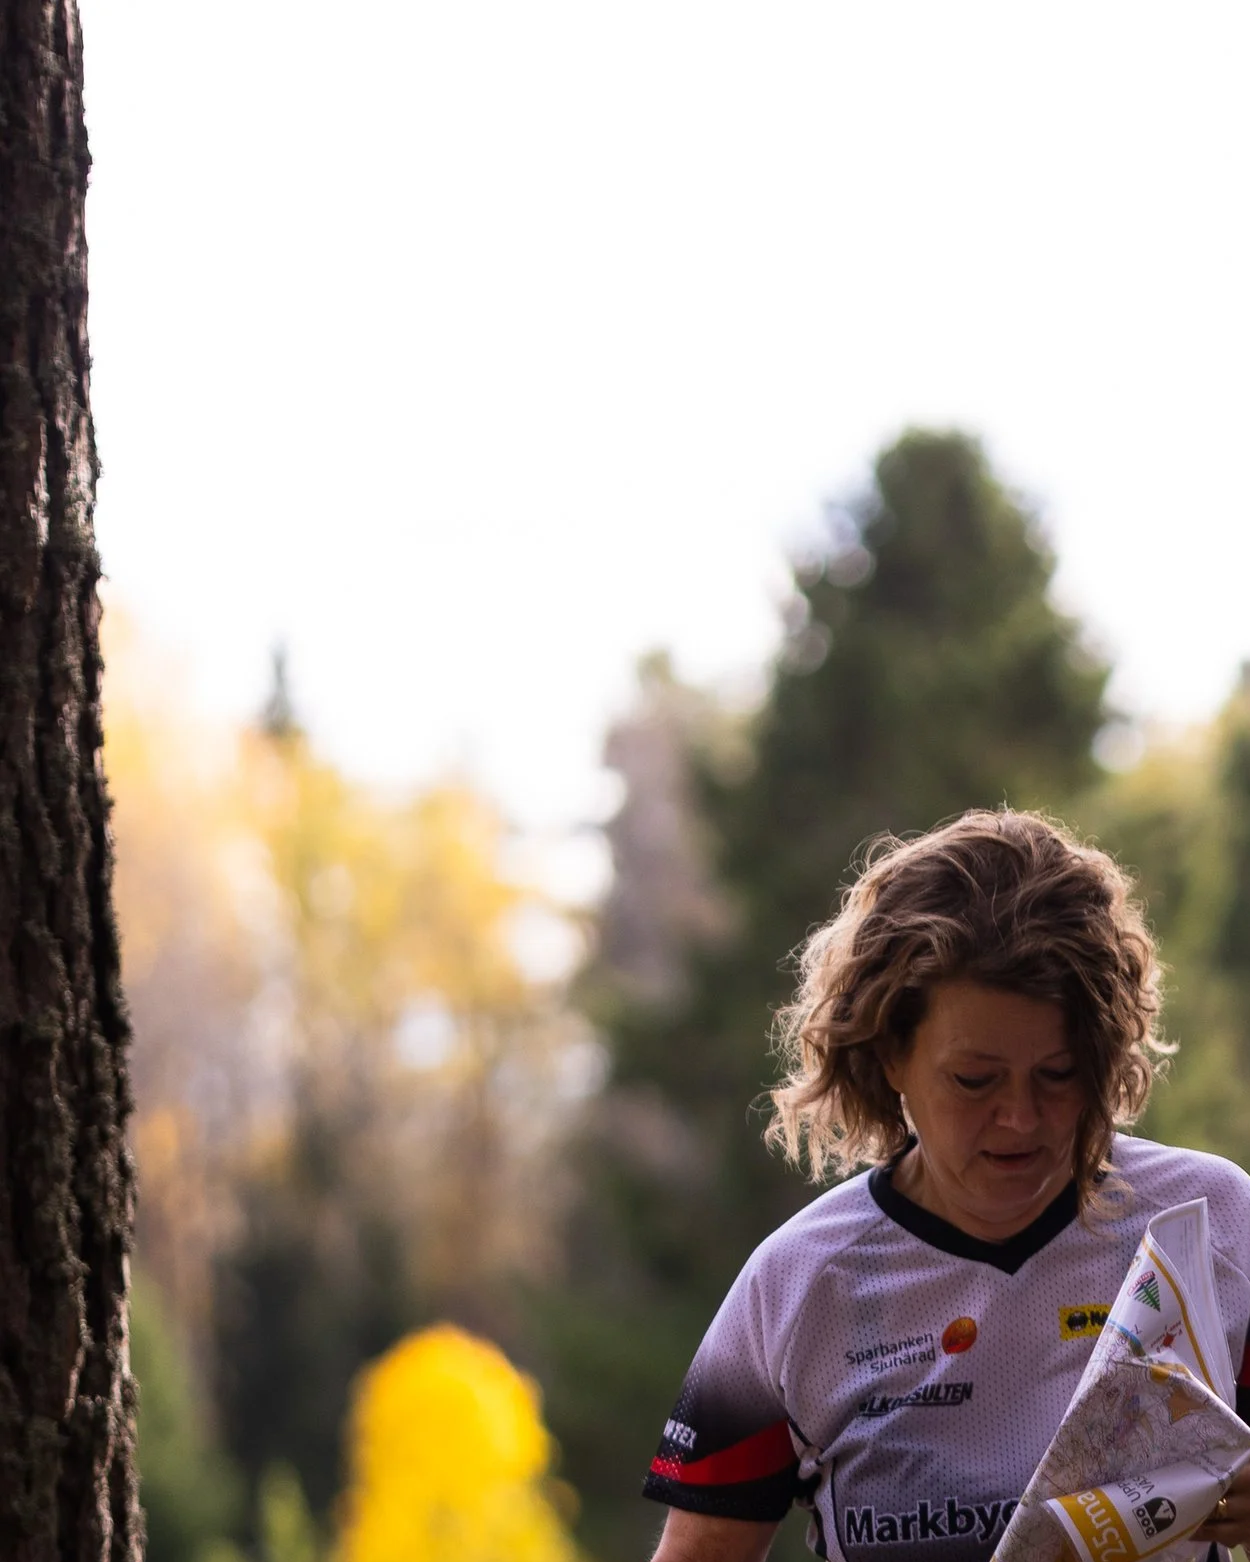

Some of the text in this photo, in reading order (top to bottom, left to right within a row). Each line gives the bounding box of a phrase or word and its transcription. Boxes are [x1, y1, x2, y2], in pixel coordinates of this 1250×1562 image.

[845, 1332, 934, 1365] Sparbanken
[1117, 1477, 1142, 1503] UPP
[1076, 1491, 1128, 1562] 25ma
